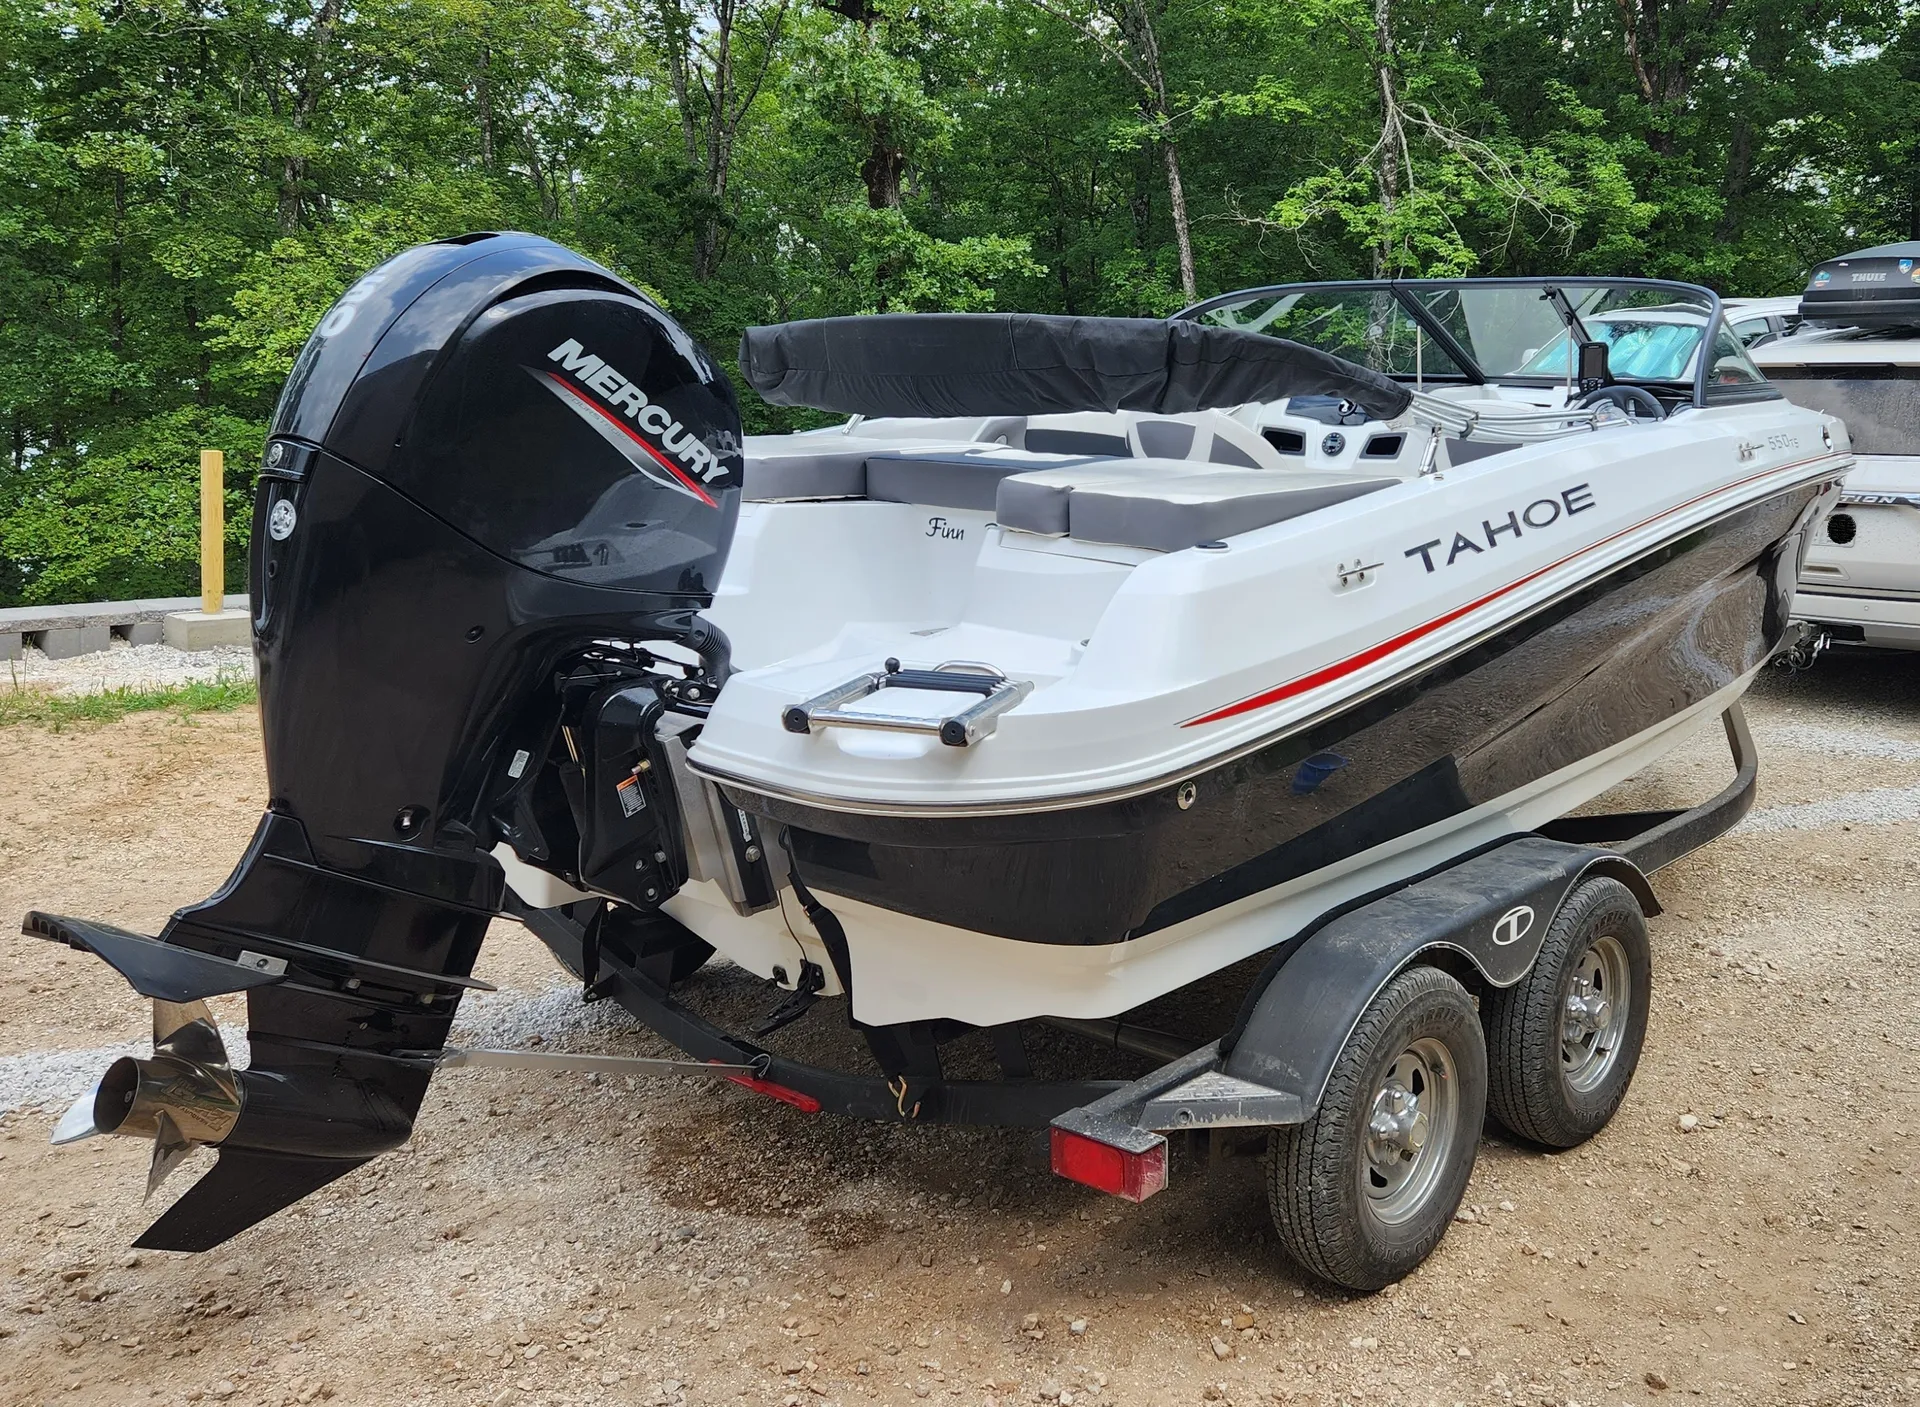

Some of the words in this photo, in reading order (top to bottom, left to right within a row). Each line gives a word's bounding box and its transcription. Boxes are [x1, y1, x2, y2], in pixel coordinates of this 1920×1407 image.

[1850, 273, 1888, 283] THULE
[547, 337, 732, 485] MERCURY
[563, 390, 632, 444] FOURSTROKE
[925, 516, 965, 541] Finn
[1403, 482, 1597, 575] TAHOE
